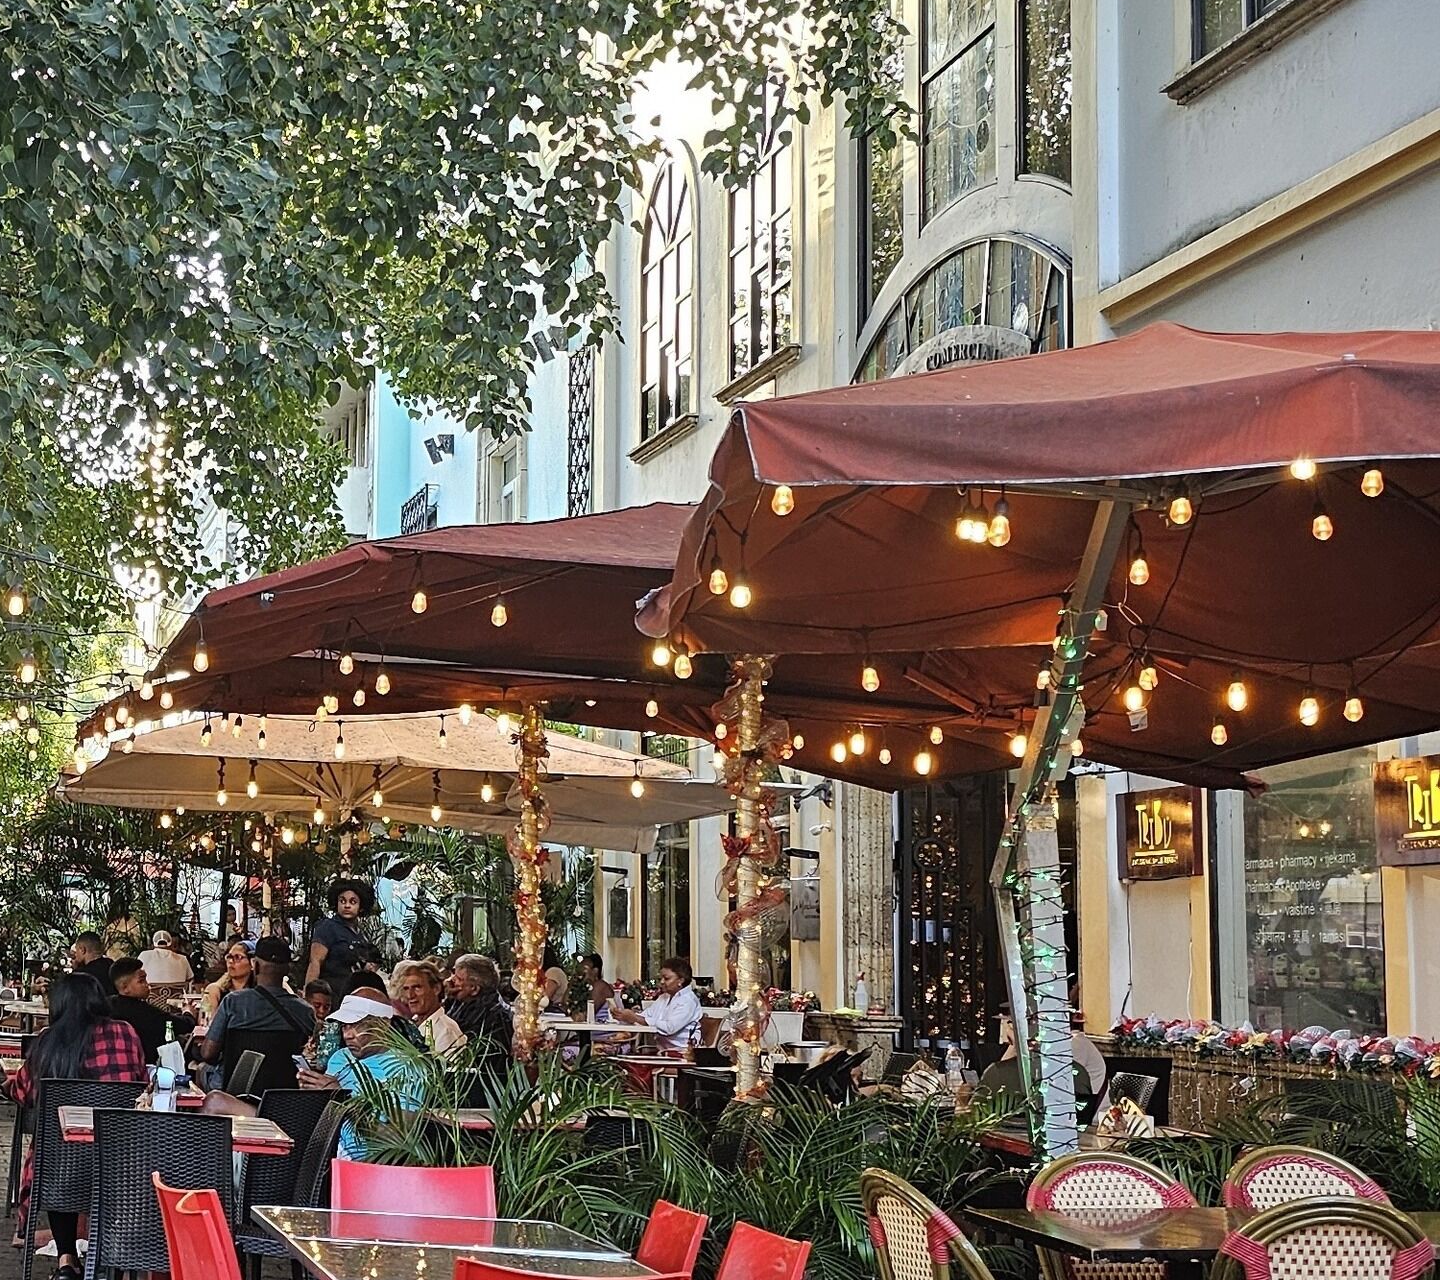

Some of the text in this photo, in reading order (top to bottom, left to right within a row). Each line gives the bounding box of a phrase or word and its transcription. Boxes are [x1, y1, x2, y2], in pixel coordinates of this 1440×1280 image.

[926, 342, 1001, 371] COMERCIAL
[1244, 858, 1274, 870] armacia
[1280, 855, 1317, 871] pharmacy
[1284, 878, 1321, 894] Apotheke
